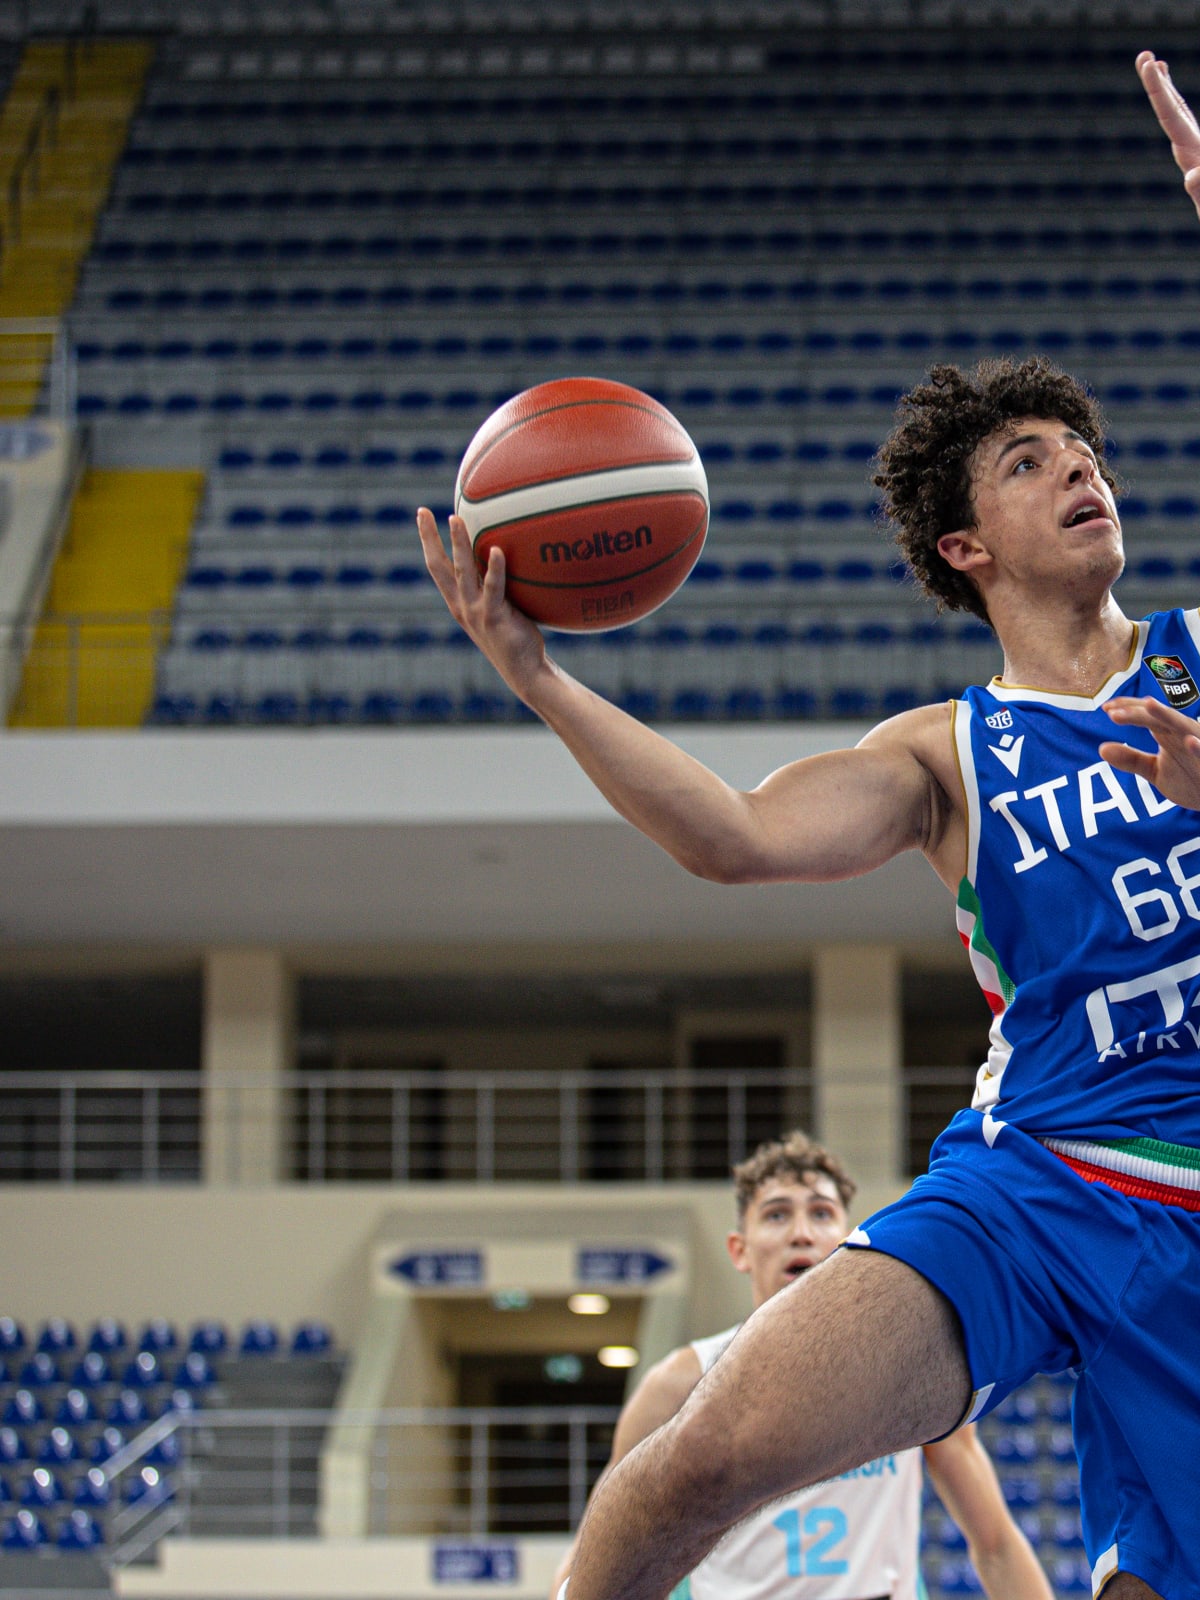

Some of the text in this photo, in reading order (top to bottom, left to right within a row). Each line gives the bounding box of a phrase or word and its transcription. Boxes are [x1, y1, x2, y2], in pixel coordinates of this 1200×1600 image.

[539, 525, 653, 563] molten
[1163, 683, 1191, 695] FIBA
[772, 1506, 849, 1578] 12
